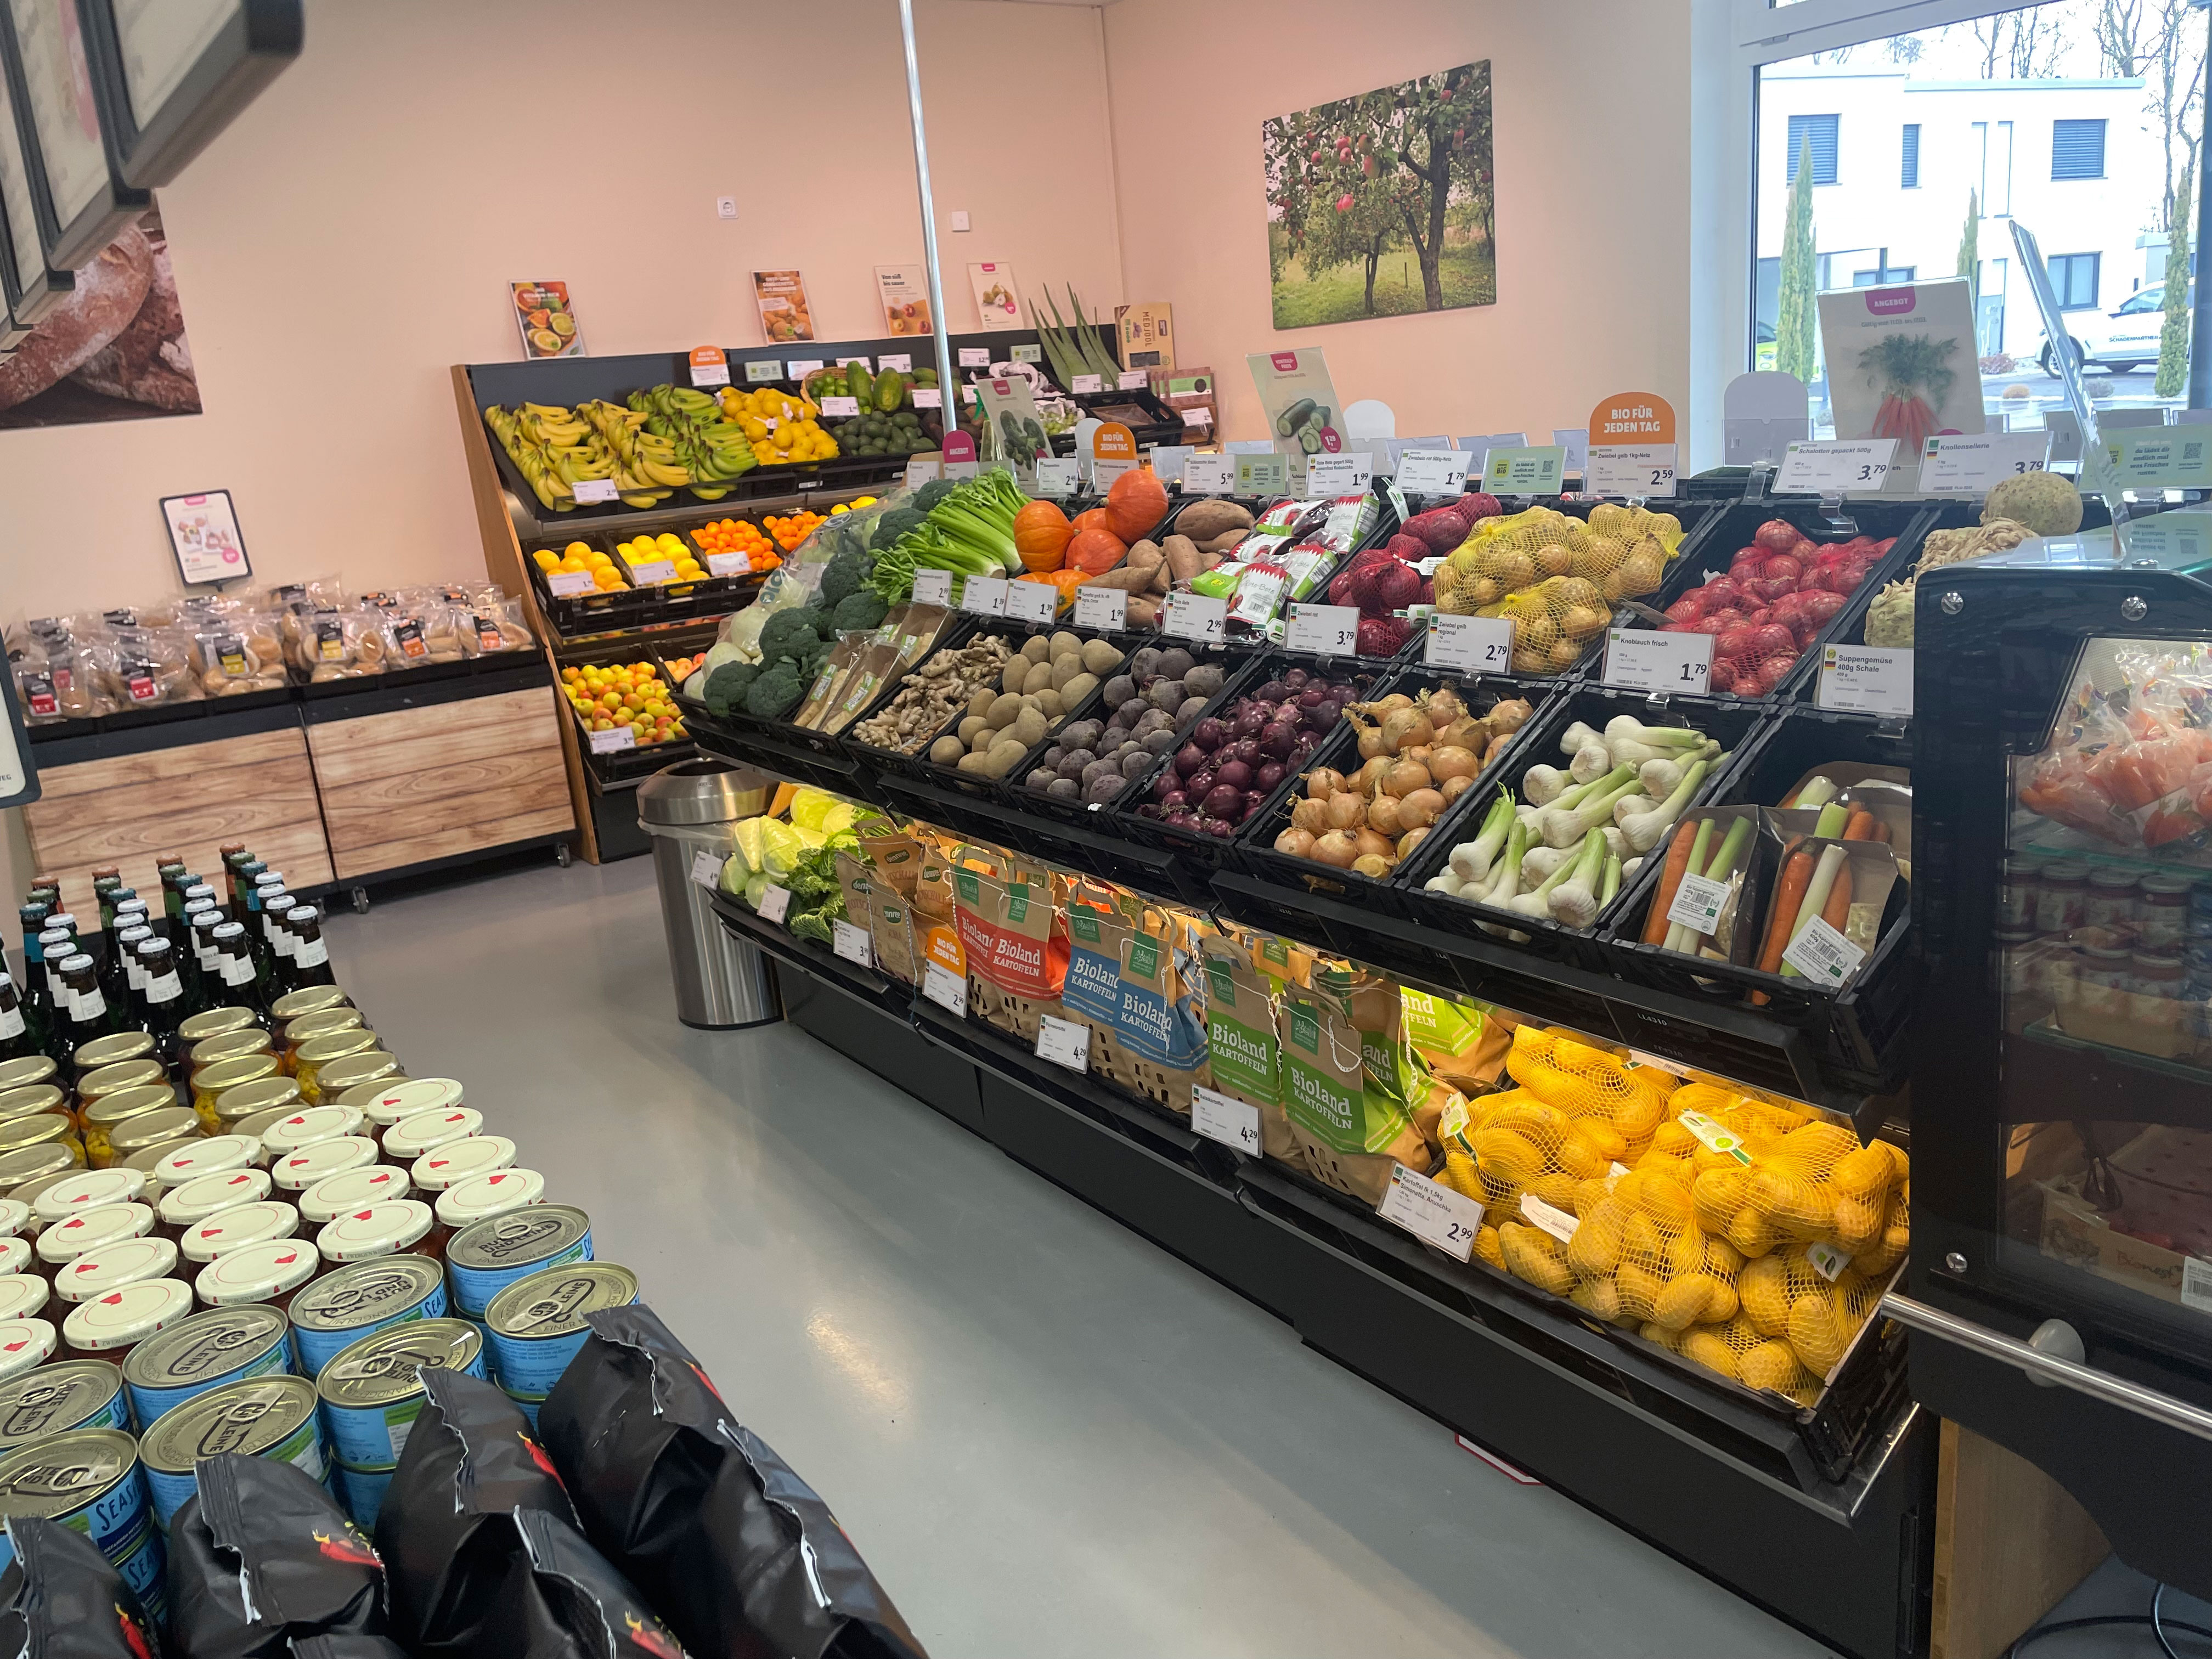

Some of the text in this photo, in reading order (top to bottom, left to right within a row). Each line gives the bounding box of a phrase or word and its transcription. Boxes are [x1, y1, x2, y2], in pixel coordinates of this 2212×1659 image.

[1874, 298, 1908, 307] ANGEBOT
[1143, 311, 1152, 347] MEDJOOL
[1611, 405, 1652, 419] BIO FÜR
[1604, 421, 1660, 433] JEDEN TAG
[1113, 432, 1124, 441] FÜR
[1221, 473, 1234, 485] 5.99
[1352, 472, 1368, 486] 1.99
[1445, 472, 1465, 485] 1.79
[1651, 470, 1673, 485] 2.59
[1857, 465, 1887, 481] 3.79
[938, 588, 949, 598] 2.99
[1110, 609, 1124, 622] 1.99
[1206, 619, 1222, 633] 2.99
[1336, 630, 1355, 646] 3.79
[1485, 645, 1508, 661] 2.79
[1838, 655, 1893, 664] Suppengemüse
[1680, 663, 1707, 681] 1.79
[1838, 664, 1854, 672] 400g
[937, 938, 957, 955] BIO FÜR
[996, 916, 1041, 966] Bioland
[933, 945, 960, 966] JEDEN TAG
[992, 956, 1040, 977] KARTOFFELN
[1071, 975, 1118, 1002] KARTOFFELN
[953, 994, 964, 1007] 2.99
[1212, 1023, 1268, 1062] Bioland
[1074, 1046, 1086, 1060] 4.29
[1212, 1043, 1267, 1076] KARTOFFELN
[1290, 1066, 1352, 1117] Bioland
[1293, 1086, 1352, 1130] KARTOFFELN
[1240, 1126, 1257, 1143] 4.29
[1402, 1175, 1424, 1190] Kartoffel
[1430, 1188, 1443, 1201] 1,5kg
[1426, 1196, 1452, 1213] Anuschka
[1447, 1223, 1472, 1243] 2.99
[346, 1247, 390, 1260] ZWERGENWIESE
[222, 1291, 267, 1304] ZWERGENWIESE
[563, 1282, 586, 1304] LEINE
[101, 1329, 150, 1346] ZWERGENWIESE
[210, 1424, 236, 1452] LEINE
